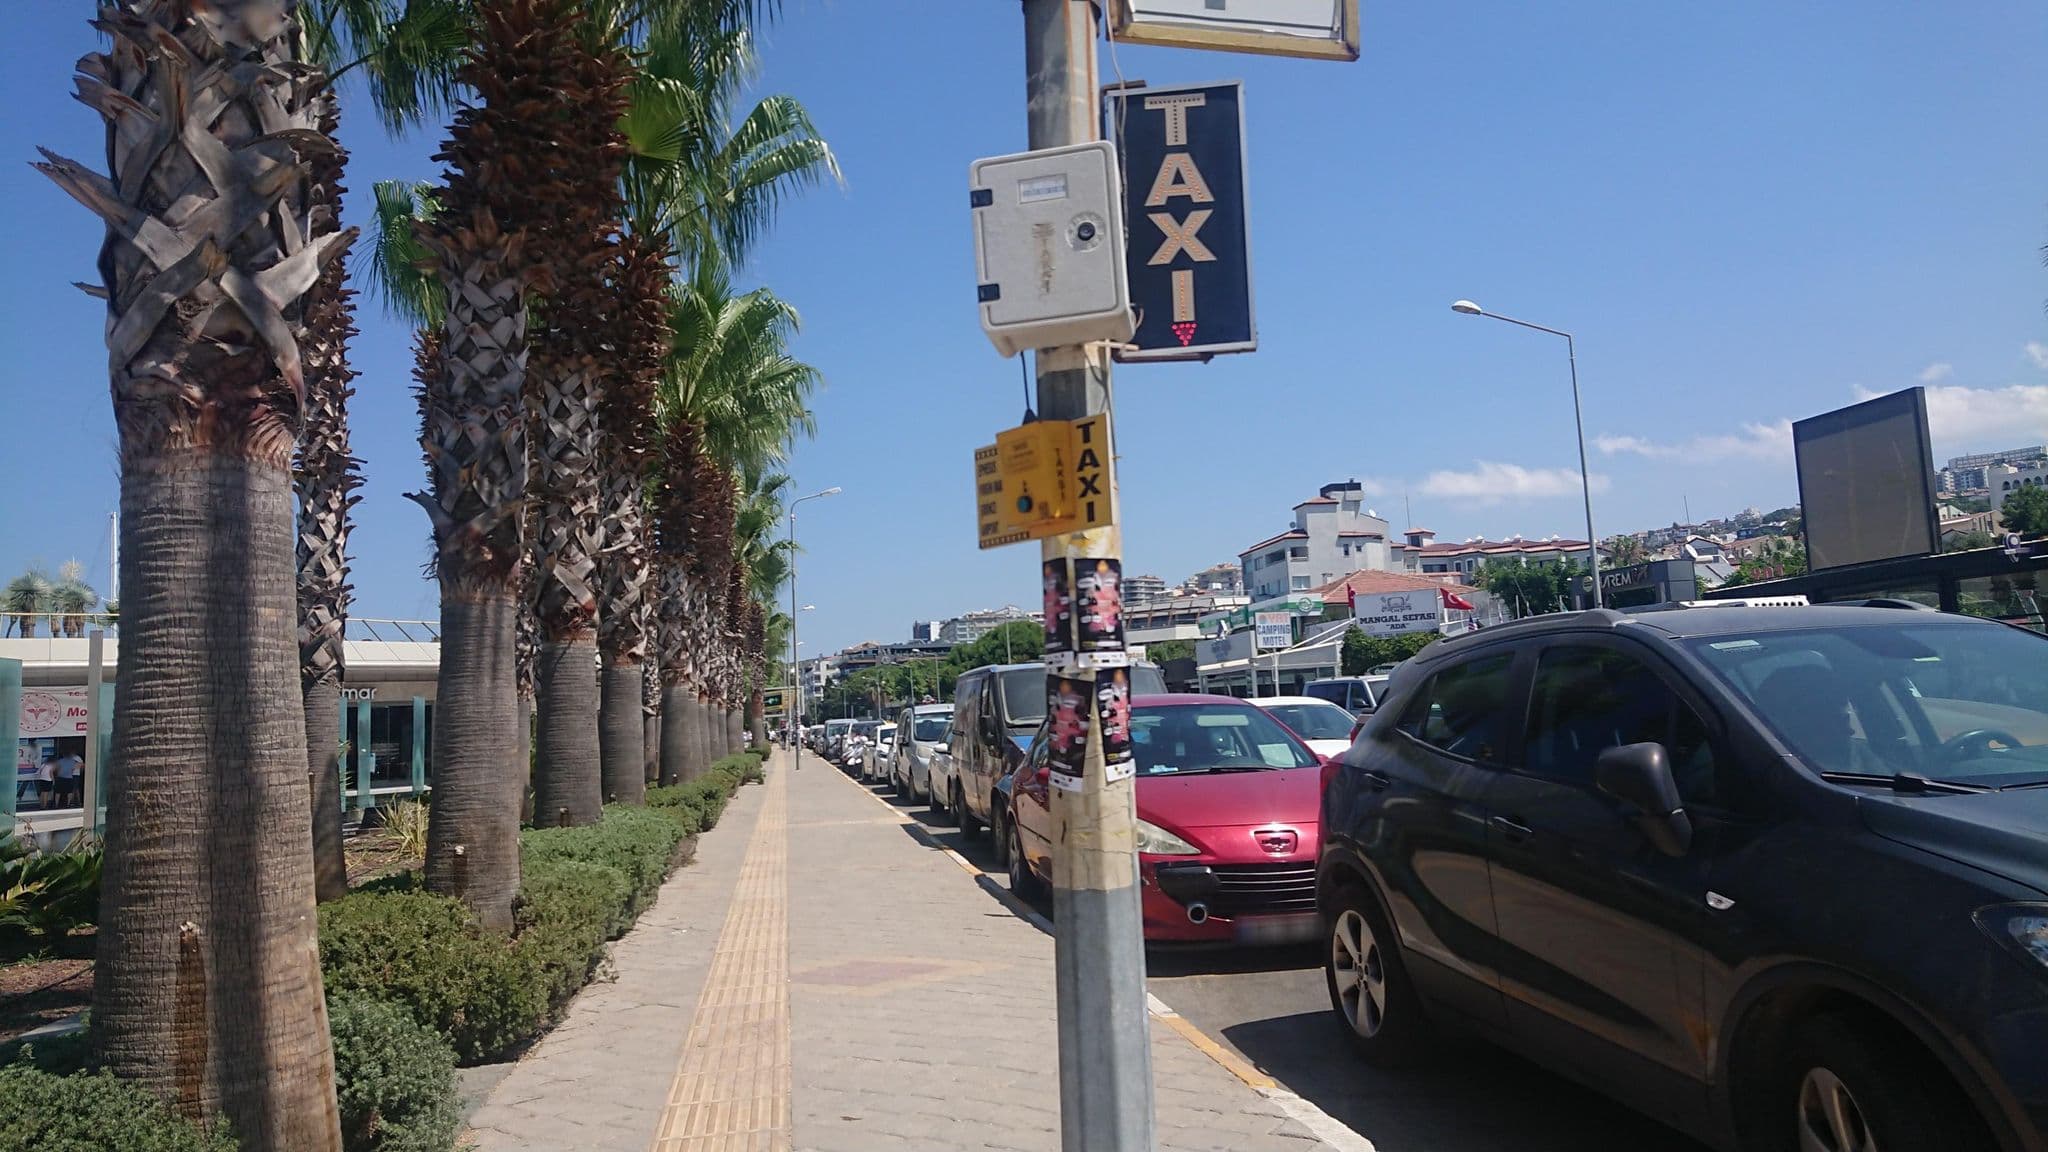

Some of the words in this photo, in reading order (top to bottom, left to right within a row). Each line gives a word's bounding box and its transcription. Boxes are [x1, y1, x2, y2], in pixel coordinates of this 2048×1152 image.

[1144, 92, 1217, 322] TAXI
[1076, 421, 1101, 522] TAXI
[1360, 615, 1401, 624] MANGAL
[1257, 624, 1291, 635] CAMPING
[1262, 636, 1288, 646] MOTEL
